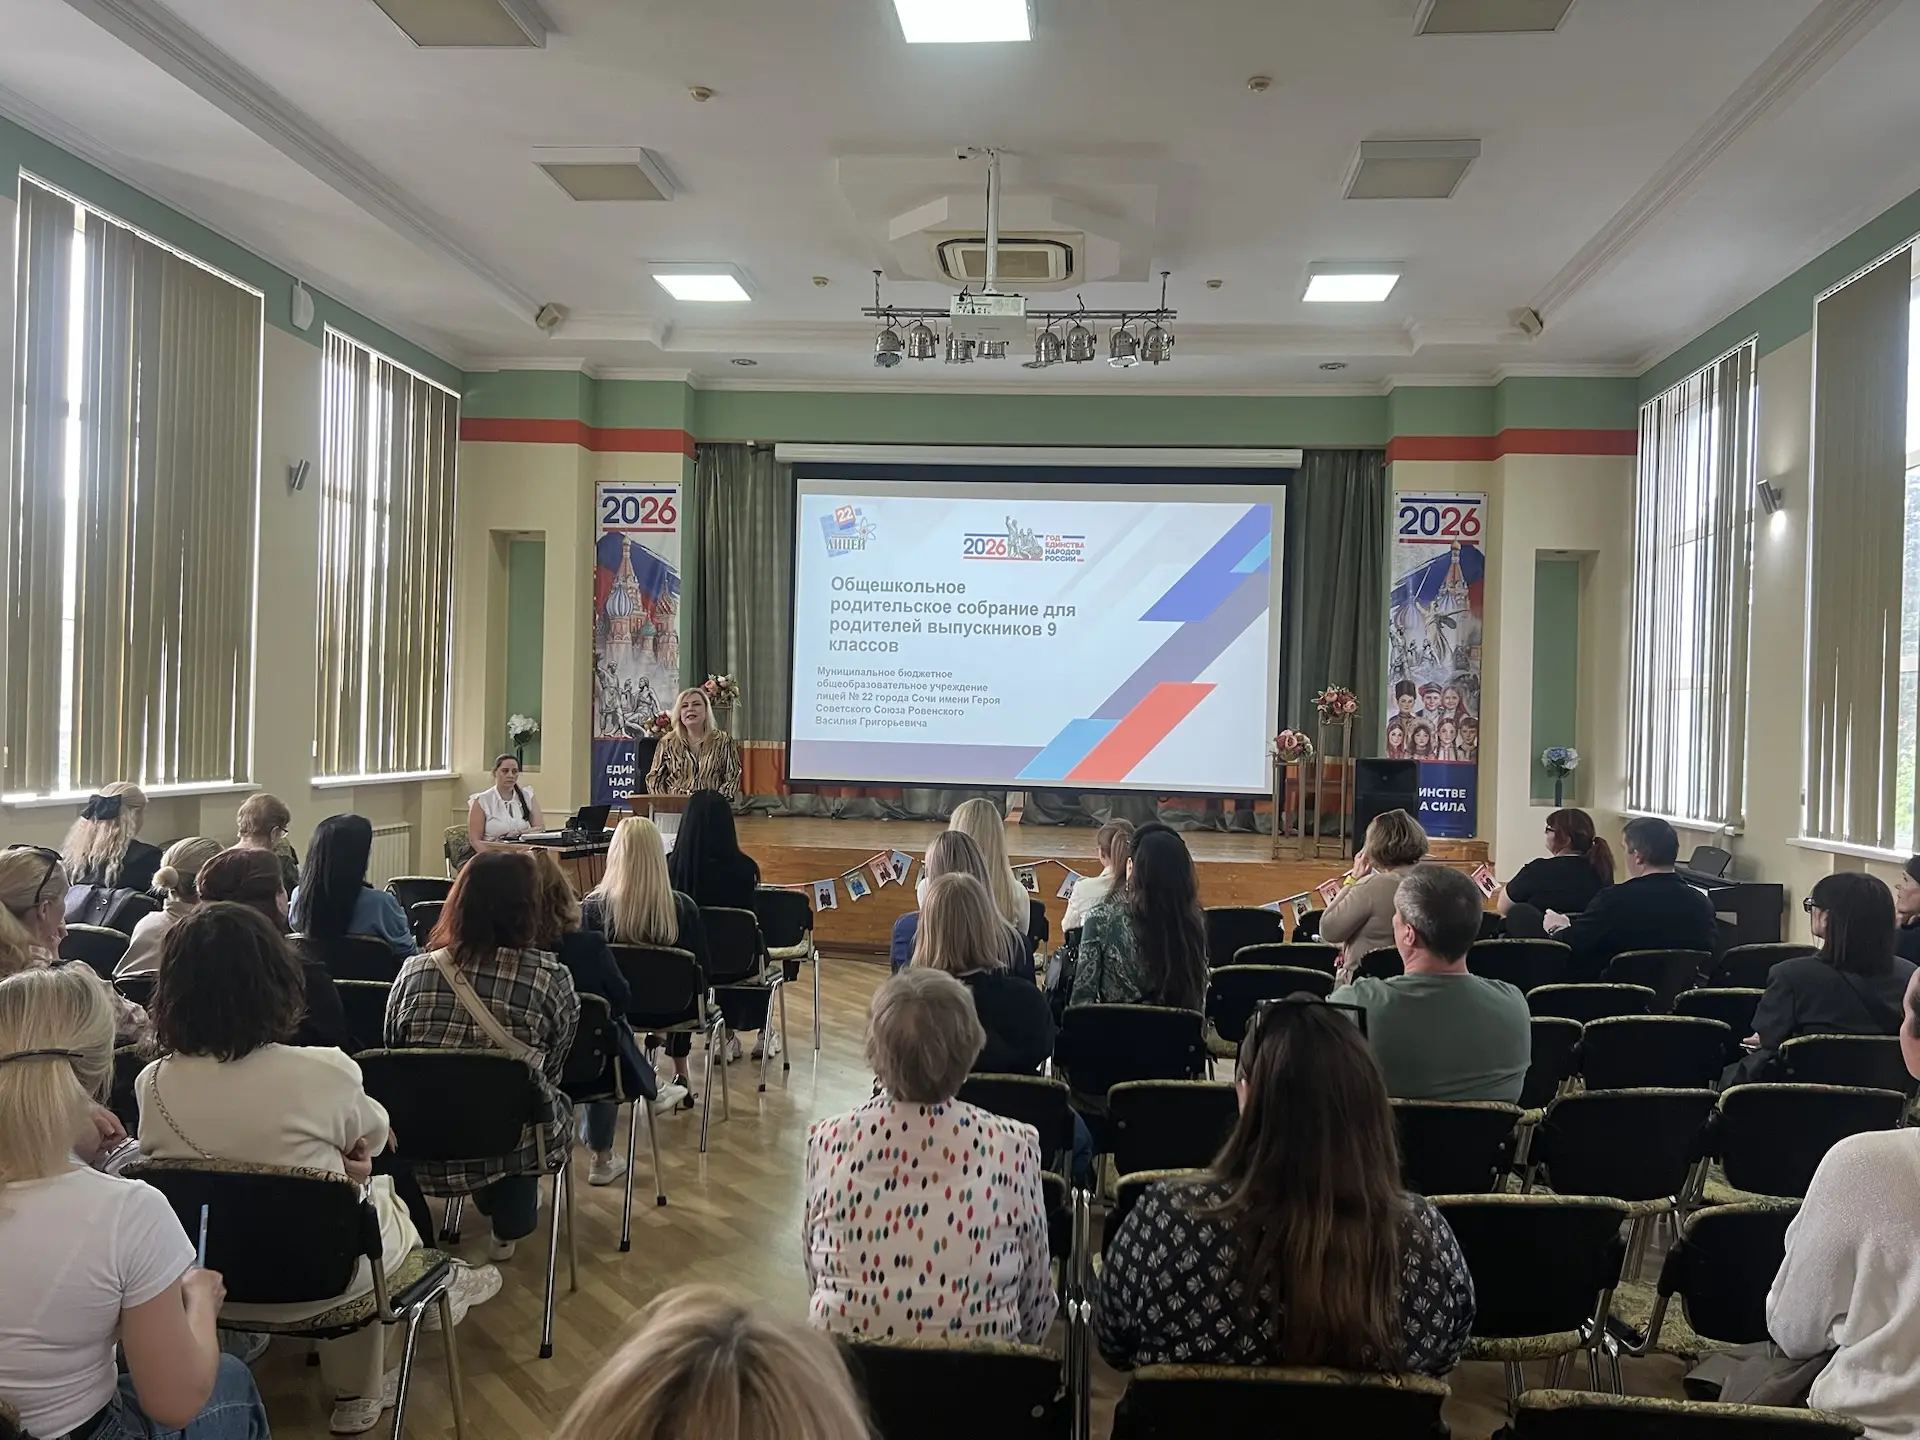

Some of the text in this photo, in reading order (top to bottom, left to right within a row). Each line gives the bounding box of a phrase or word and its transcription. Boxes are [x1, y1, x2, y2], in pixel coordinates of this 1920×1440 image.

[602, 496, 677, 524] 2026
[837, 507, 854, 522] 22
[1399, 506, 1480, 536] 2026
[826, 537, 866, 550] ЛИЦЕЙ
[963, 538, 1007, 555] 2026
[831, 576, 966, 594] Общешкольное
[830, 599, 1076, 618] родительское собрание для
[829, 618, 1057, 638] родителей выпускников 9
[829, 640, 899, 652] классов
[817, 666, 953, 678] Муниципальное бюджетное
[816, 679, 988, 692] общеобразовательное учреждение
[816, 692, 846, 702] лицей
[848, 692, 860, 701] №
[862, 692, 873, 701] 22
[875, 694, 909, 704] города
[911, 693, 936, 703] Сочи
[971, 695, 1001, 706] Героя
[815, 704, 964, 716] Советского Союза Ровенского
[815, 716, 928, 728] Василия Григорьевича
[1418, 787, 1467, 799] ИНСТВЕ
[1431, 801, 1467, 812] СИЛА
